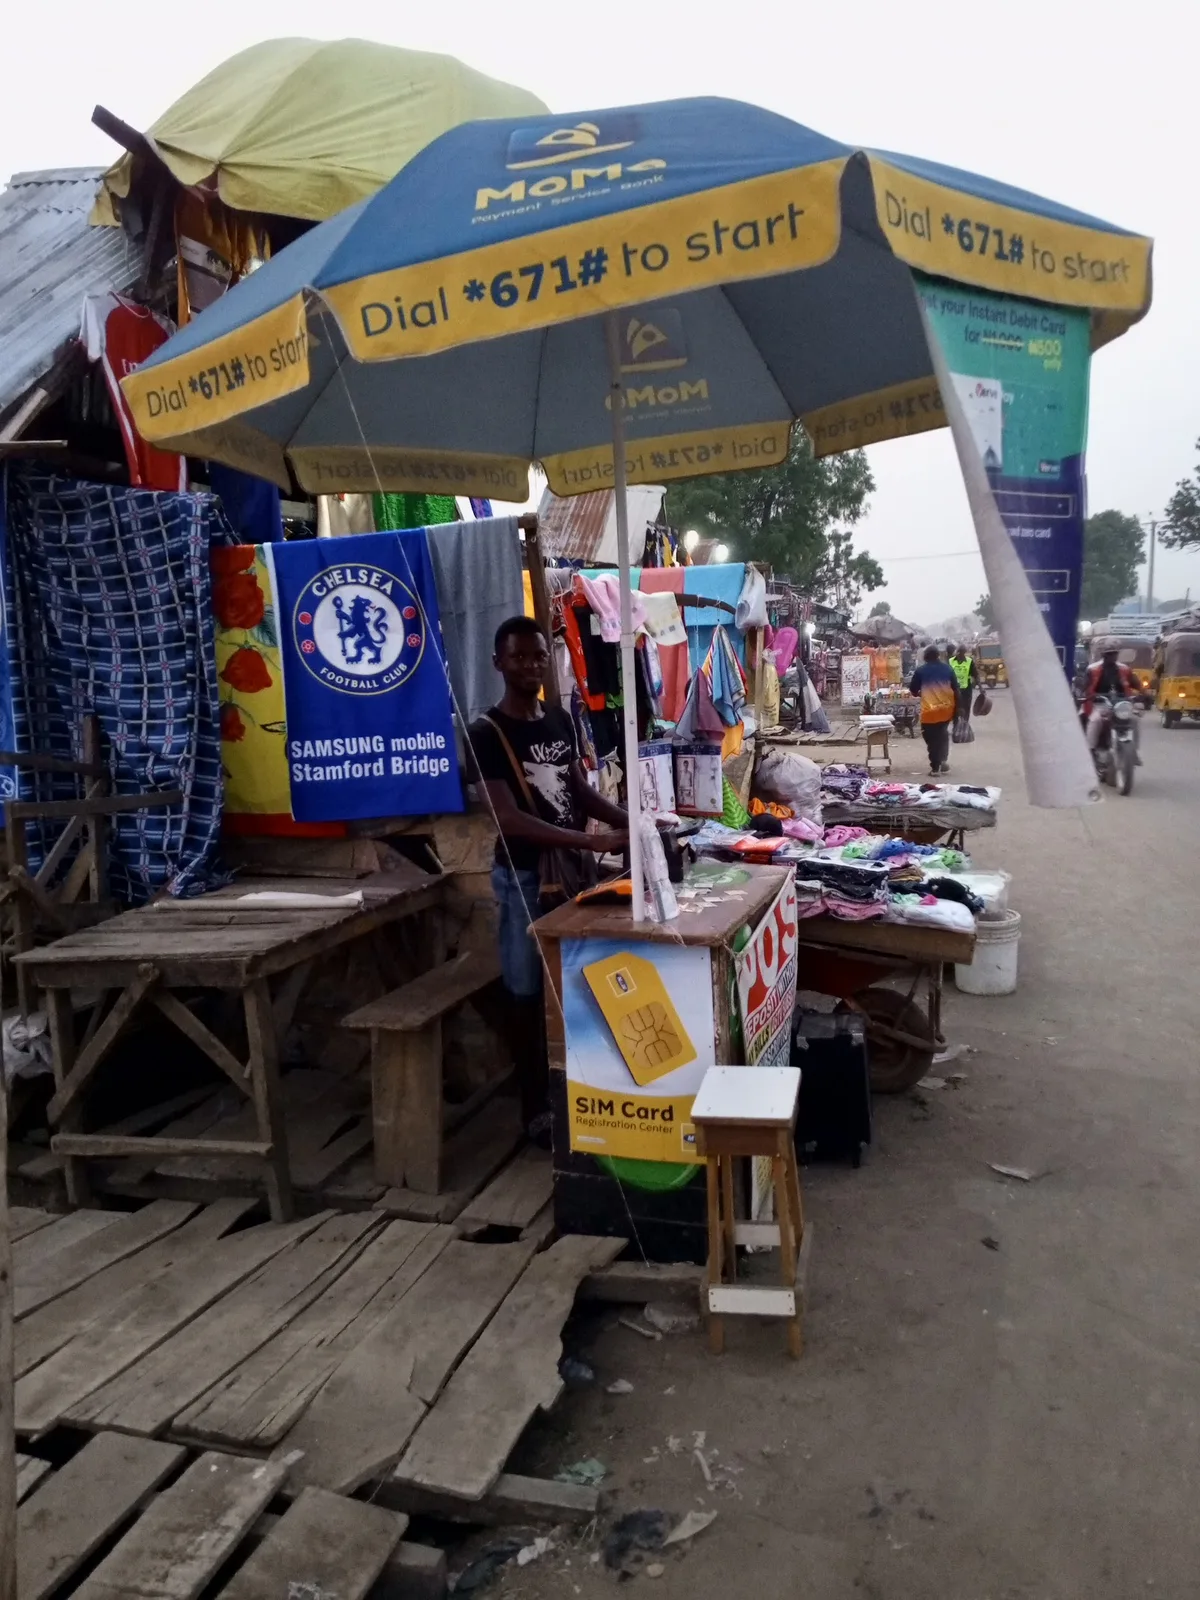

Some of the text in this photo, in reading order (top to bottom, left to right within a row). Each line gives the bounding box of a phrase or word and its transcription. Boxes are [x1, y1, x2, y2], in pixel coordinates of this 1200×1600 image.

[471, 173, 664, 224] Payment Service Bank
[885, 188, 931, 242] Dial
[1031, 240, 1056, 274] to
[1063, 250, 1131, 283] start
[360, 286, 449, 337] Dial
[622, 241, 669, 277] to
[686, 202, 805, 262] start
[941, 300, 966, 317] your
[969, 300, 1008, 323] Instant
[1009, 311, 1038, 332] Debit
[1040, 317, 1066, 336] Card
[964, 325, 981, 344] for
[146, 380, 188, 418] Dial
[245, 354, 267, 381] to
[269, 327, 307, 372] start
[312, 568, 394, 597] CHELSEA
[320, 662, 408, 689] FOOTBALL CLUB
[291, 732, 446, 759] SAMSUNG mobile
[292, 755, 450, 782] Stamford Bridge
[575, 1096, 674, 1122] SIM Card
[575, 1115, 674, 1134] Registration Center
